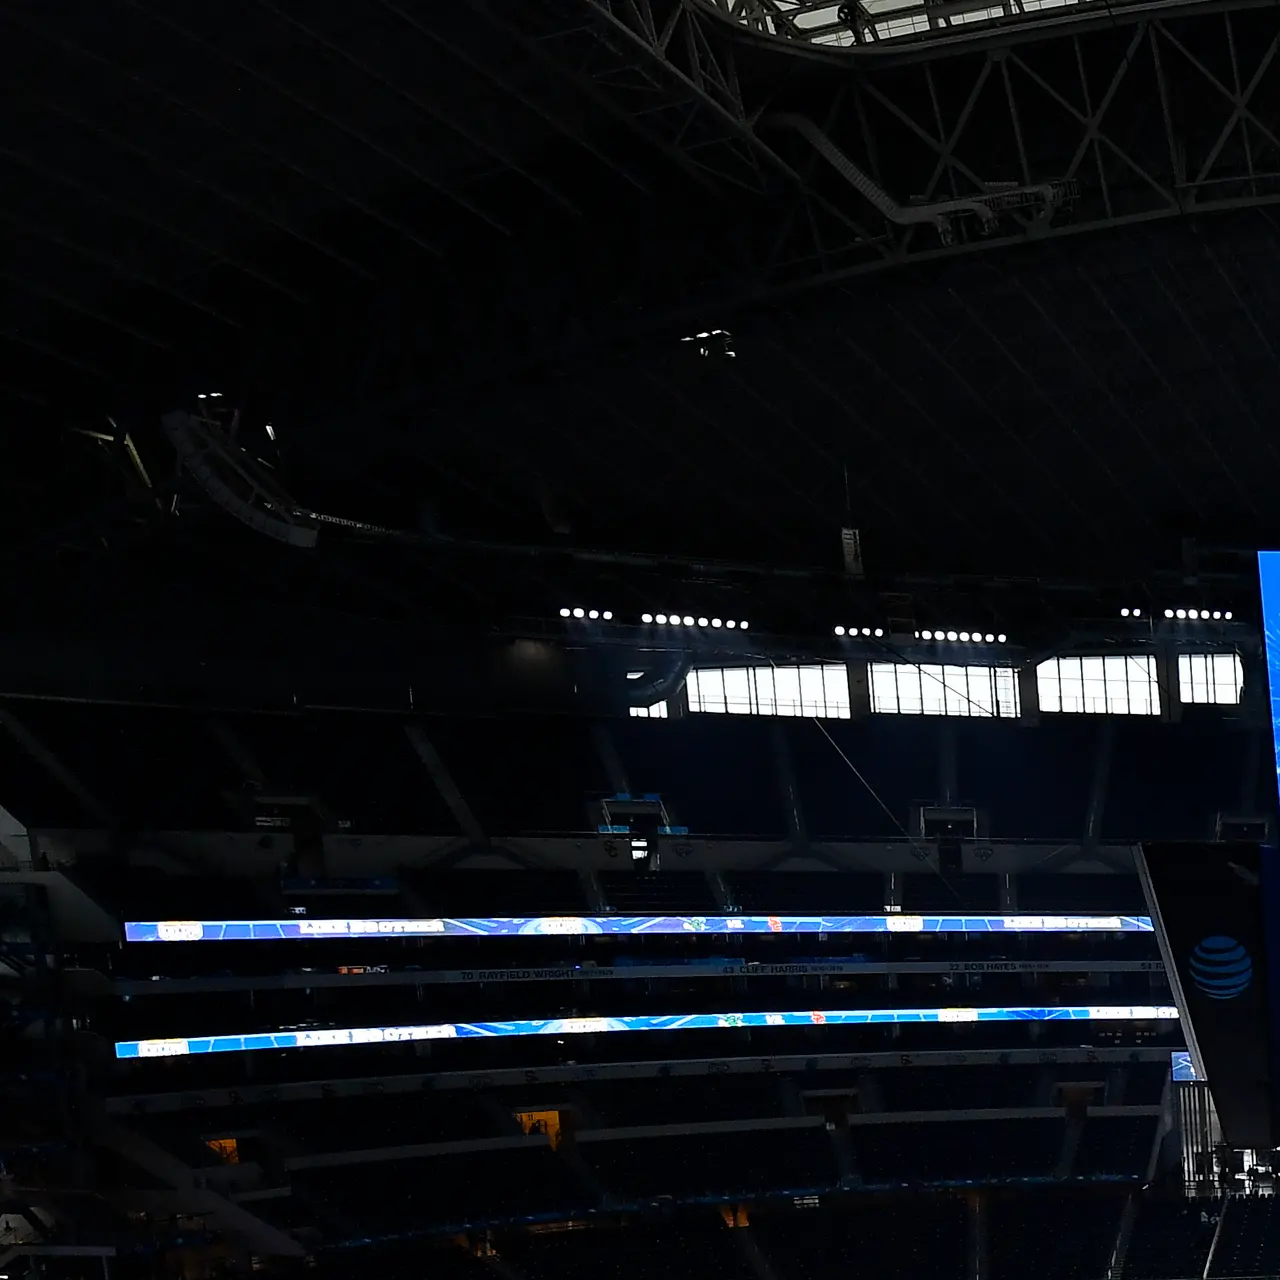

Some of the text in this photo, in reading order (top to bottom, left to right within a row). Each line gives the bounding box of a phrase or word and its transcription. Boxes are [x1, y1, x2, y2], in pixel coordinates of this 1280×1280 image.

[771, 965, 808, 974] HARRIS
[964, 962, 985, 971] BOB
[986, 962, 1017, 971] HAYES
[479, 971, 531, 980] RAYFIELD
[534, 969, 576, 978] WRIGHT
